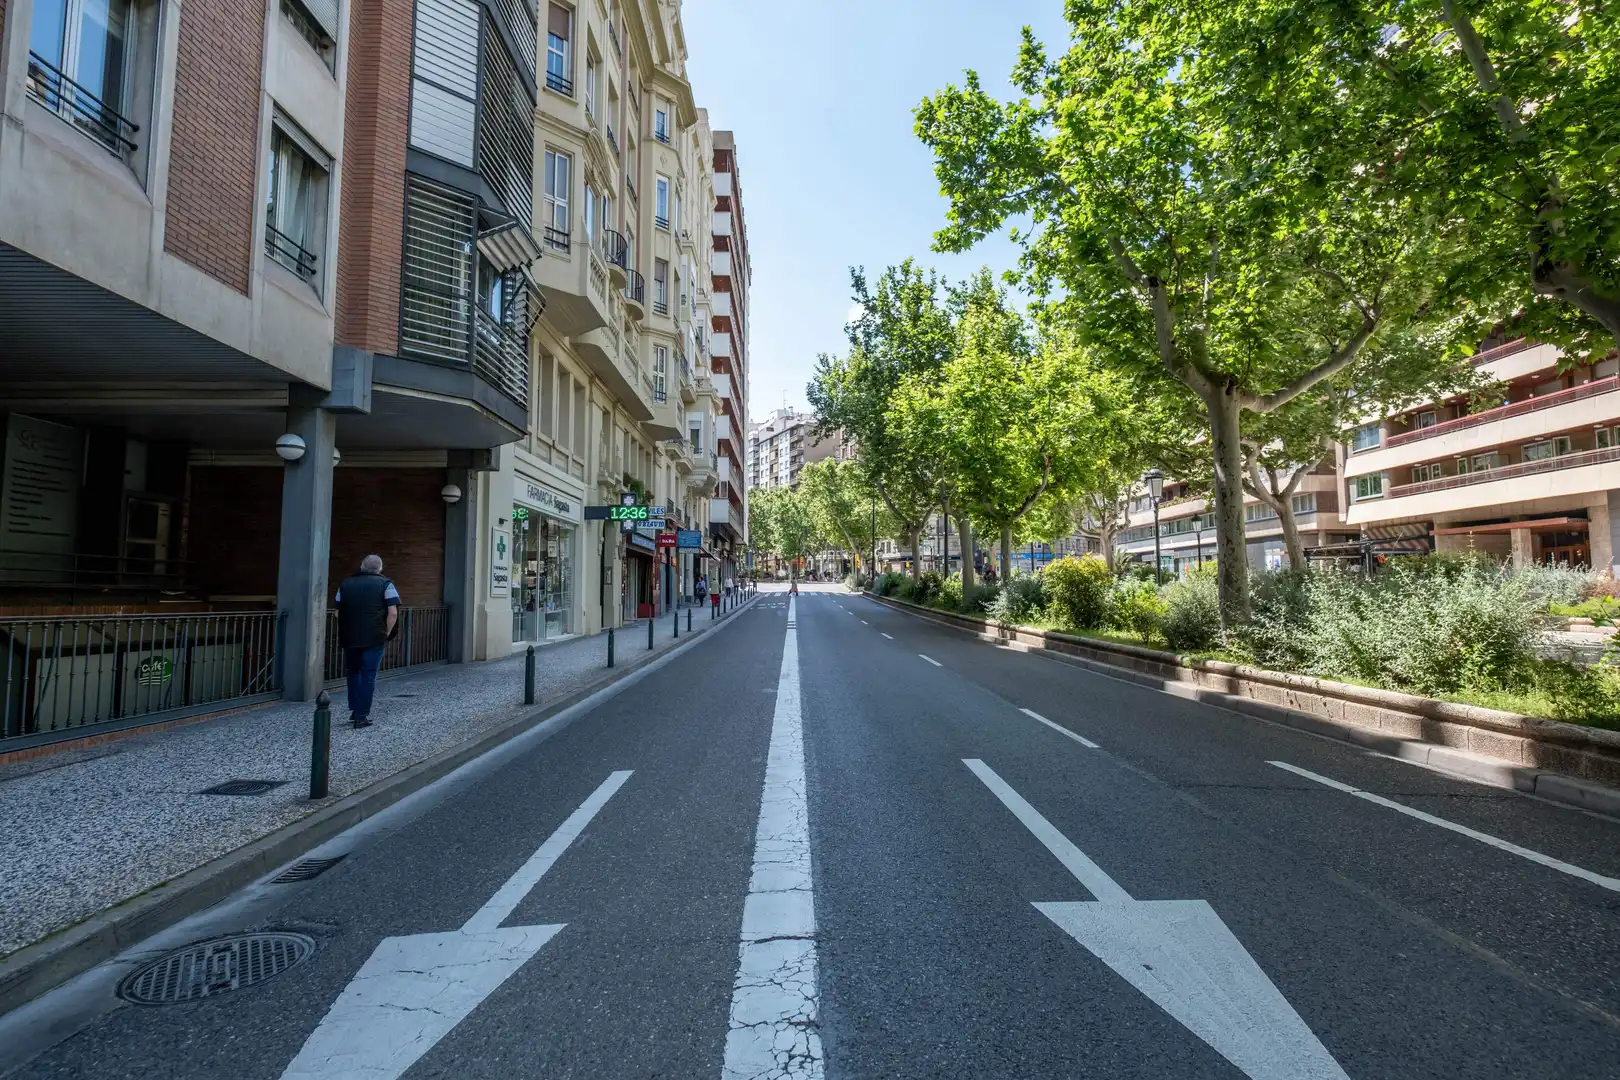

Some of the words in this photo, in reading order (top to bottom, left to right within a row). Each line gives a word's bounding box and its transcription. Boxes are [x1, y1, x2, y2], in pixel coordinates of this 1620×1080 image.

[527, 484, 553, 507] FARMACIA
[553, 495, 569, 513] Sagasta
[610, 507, 647, 519] 12:36
[648, 507, 665, 515] VILES
[493, 573, 508, 584] Sagasta
